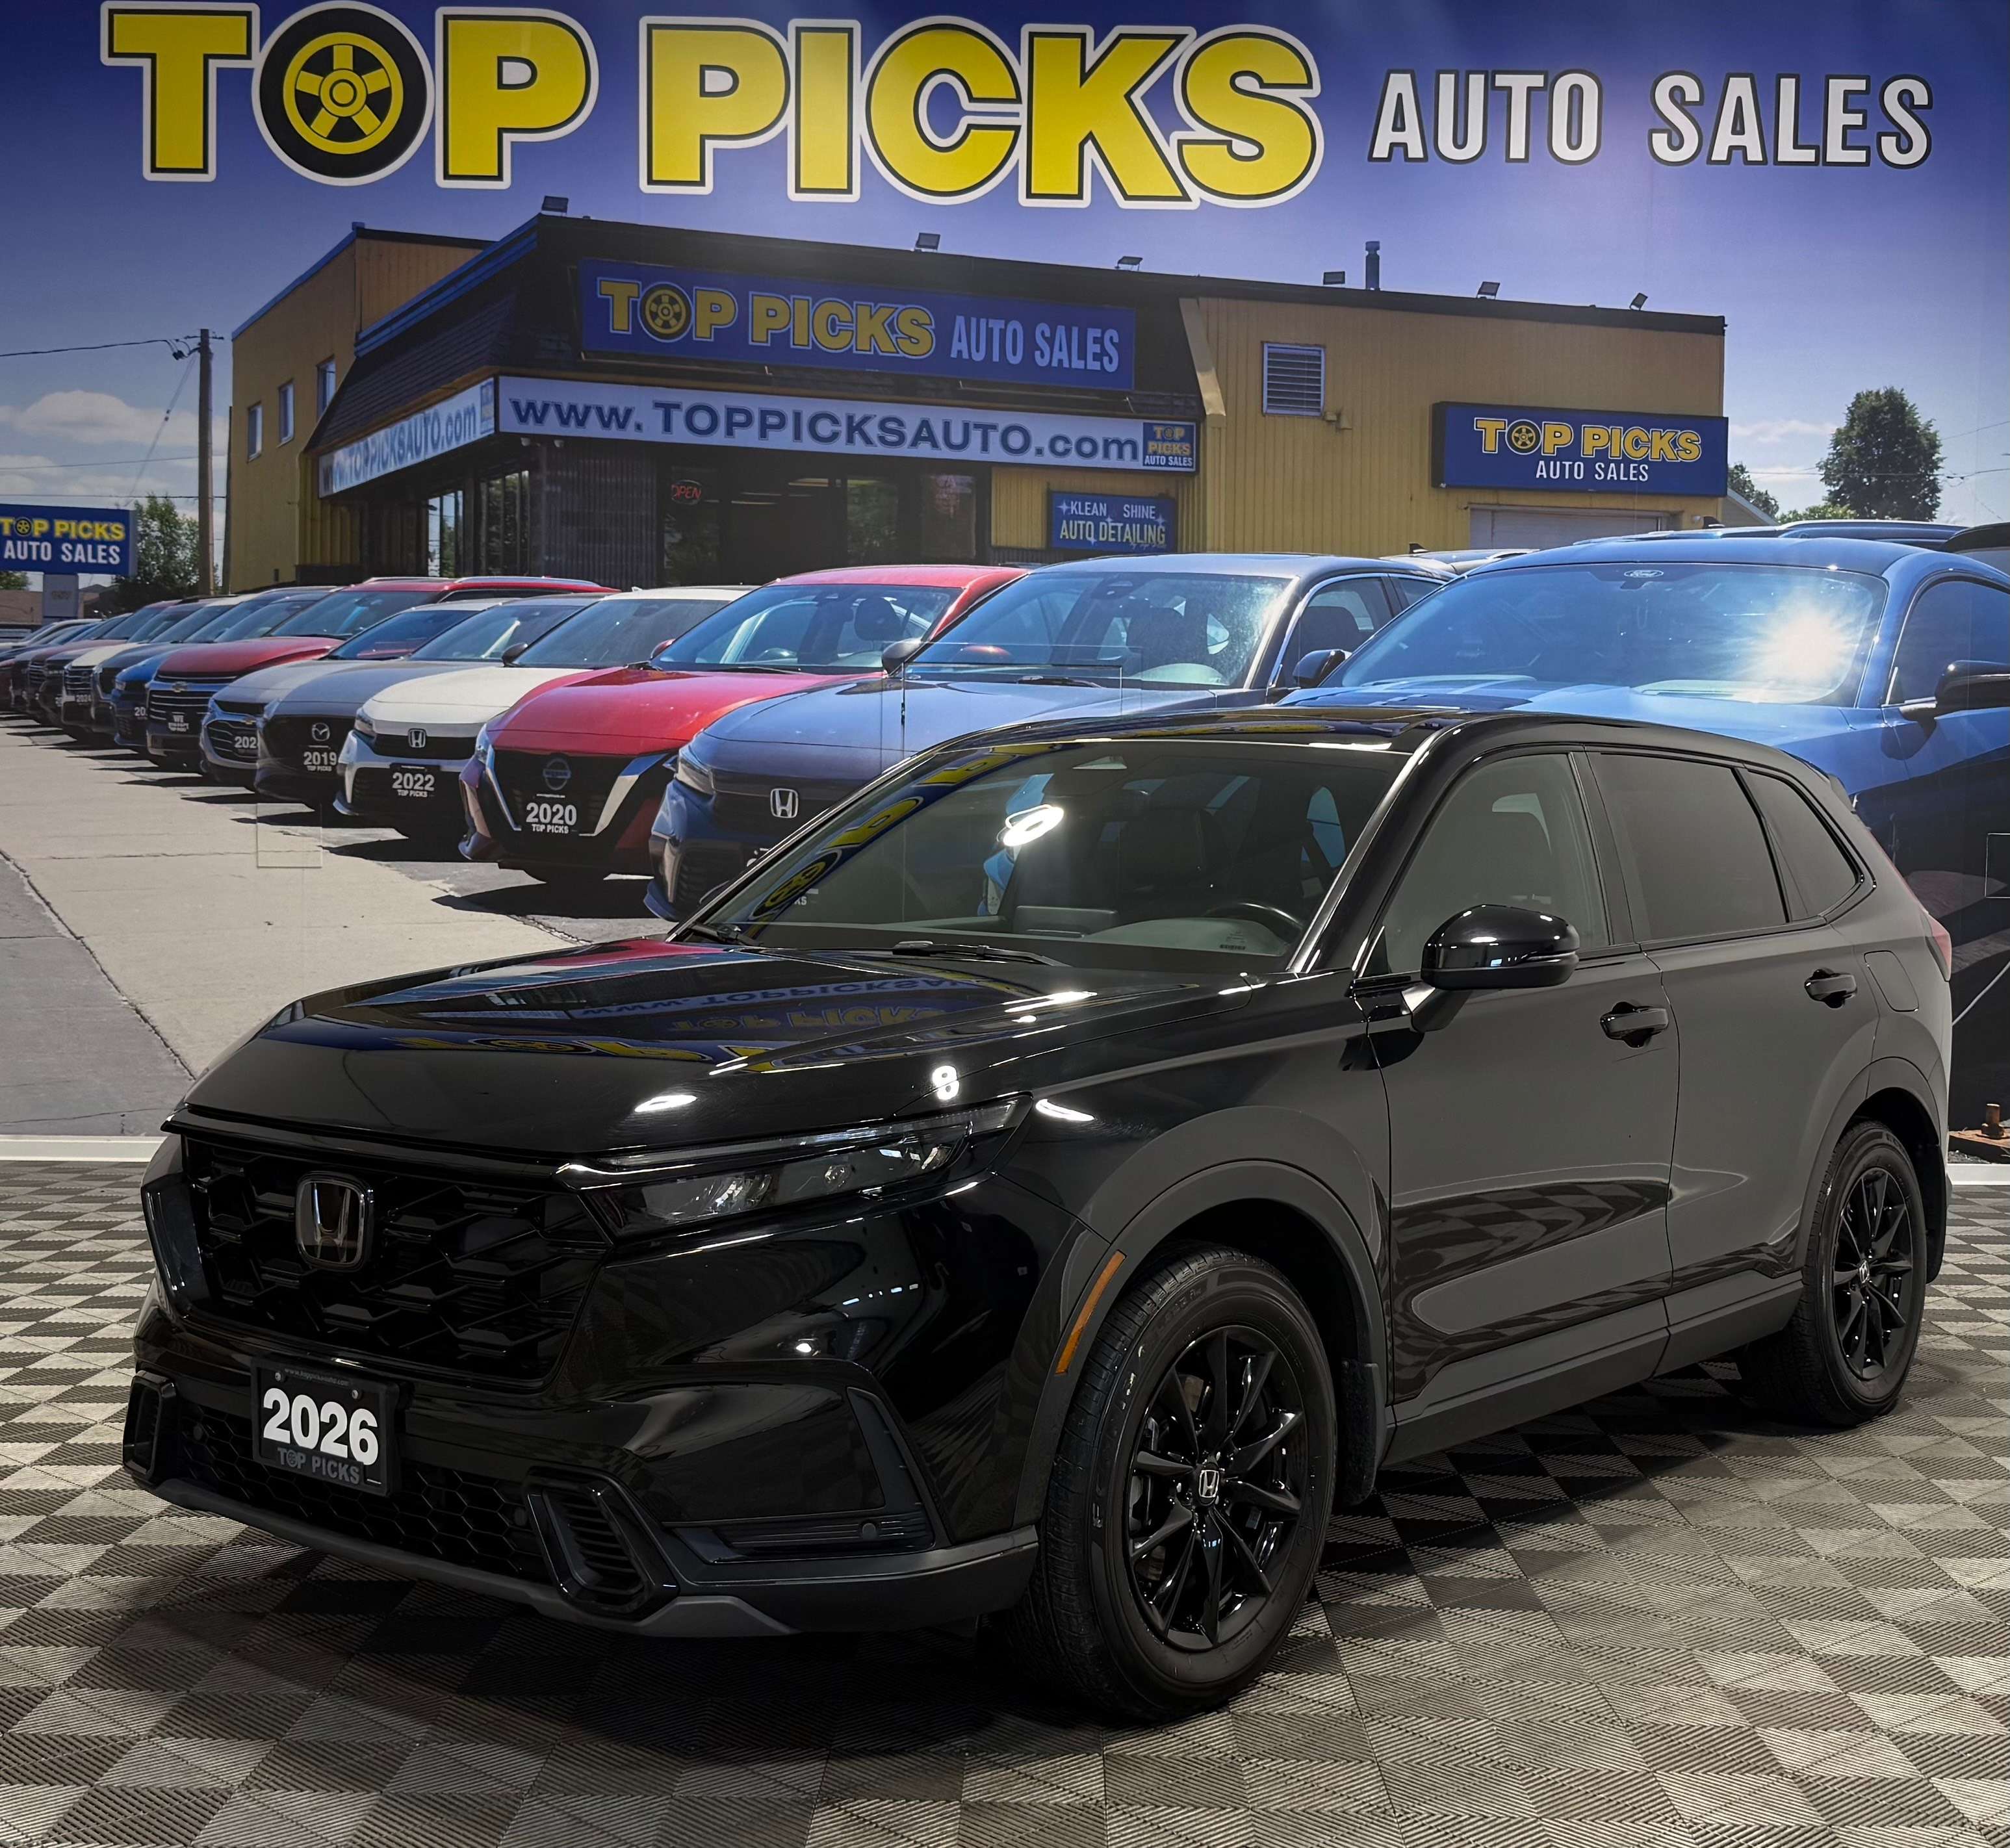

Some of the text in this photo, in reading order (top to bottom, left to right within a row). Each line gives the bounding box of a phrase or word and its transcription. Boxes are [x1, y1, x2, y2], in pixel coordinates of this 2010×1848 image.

[99, 1, 1933, 211] TOP PICKS AUTO SALES
[597, 277, 1120, 373] TOP PICKS AUTO SALES
[1153, 425, 1185, 441] TOP
[1474, 417, 1702, 462] TOP PICKS
[1148, 441, 1192, 456] PICKS
[1144, 455, 1192, 467] AUTO SALES
[1536, 460, 1649, 481] AUTO SALES
[1070, 500, 1155, 519] KLEAN SHINE
[0, 517, 125, 541] TOP PICKS
[1060, 519, 1166, 545] AUTO DETAILING
[4, 540, 120, 565] AUTO SALES
[234, 736, 259, 749] 202
[303, 751, 337, 766] 2019
[392, 772, 435, 791] 2022
[526, 802, 577, 825] 2020
[532, 824, 569, 834] TOP PICKS
[263, 1387, 379, 1466] 2026
[277, 1447, 360, 1485] TOP PICKS
